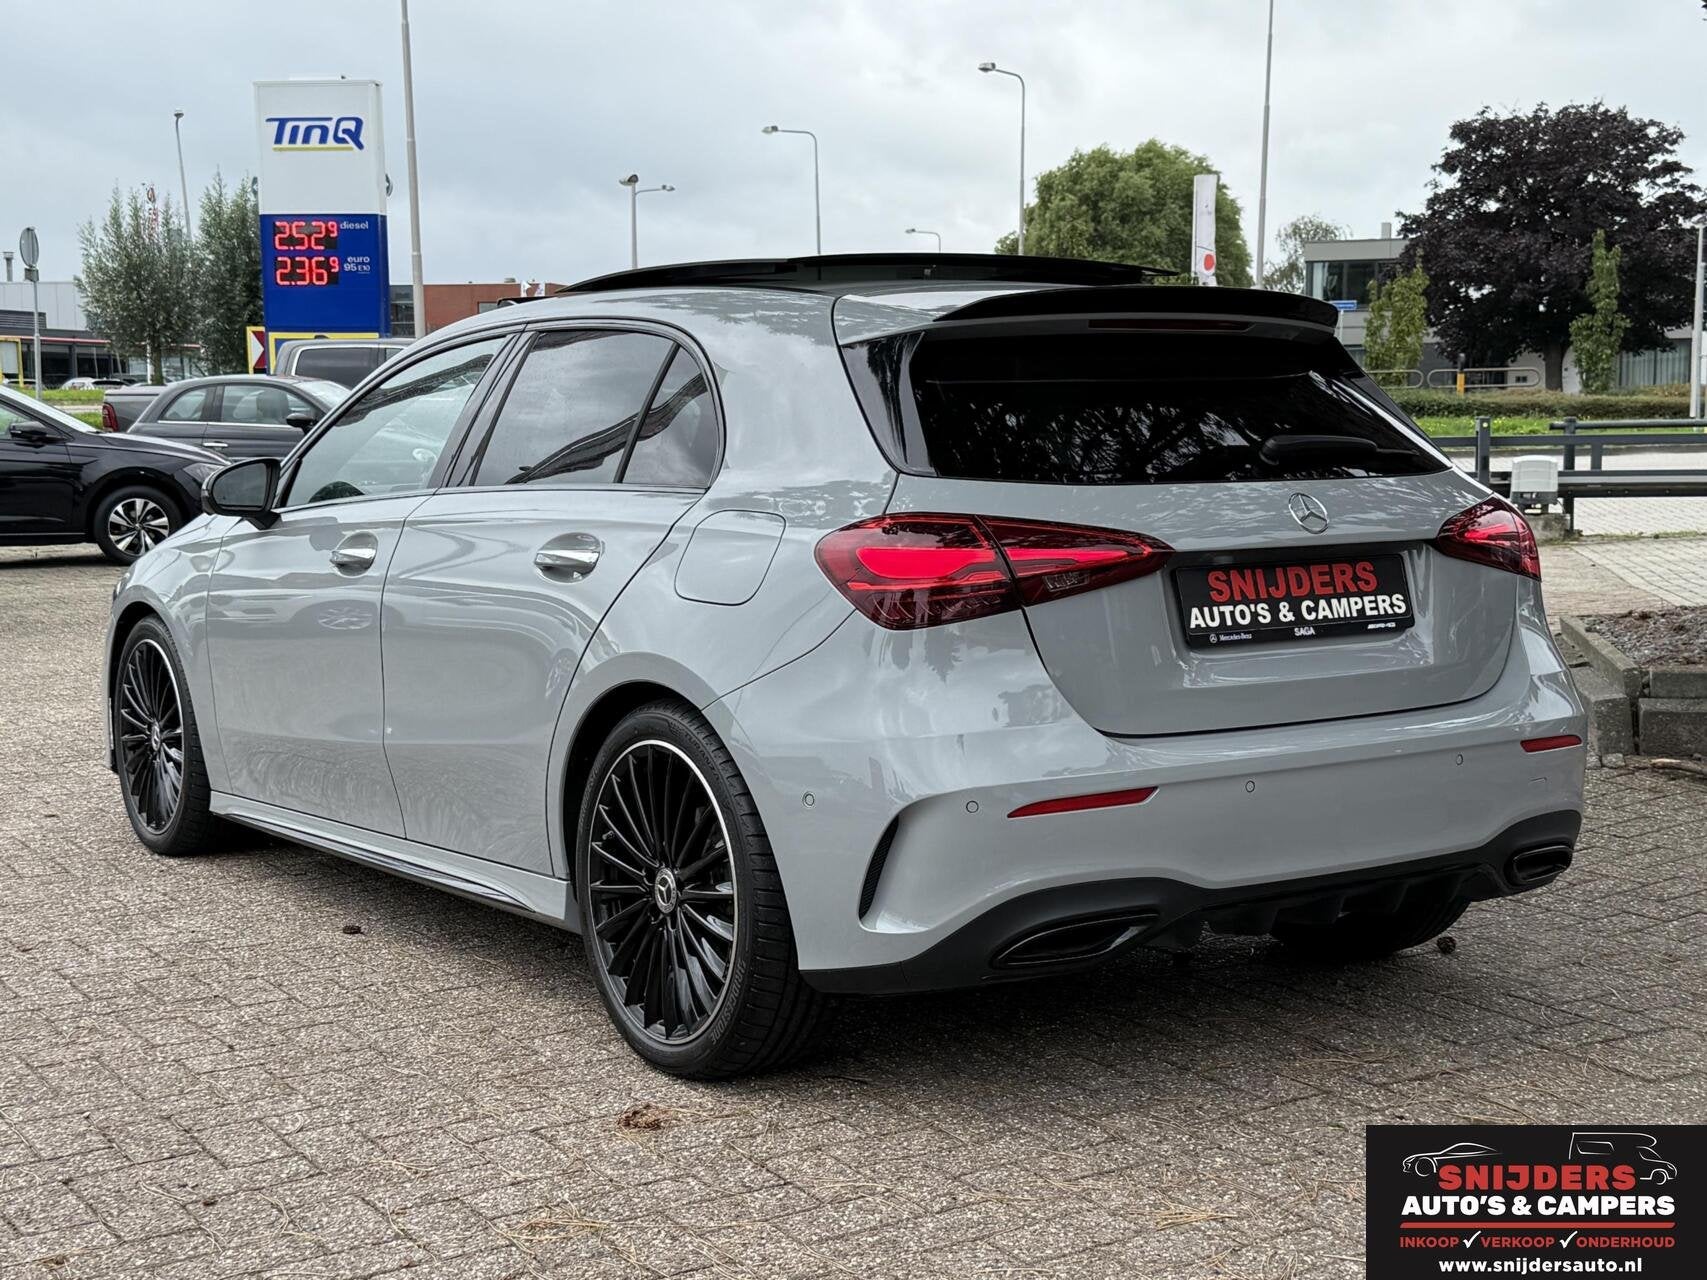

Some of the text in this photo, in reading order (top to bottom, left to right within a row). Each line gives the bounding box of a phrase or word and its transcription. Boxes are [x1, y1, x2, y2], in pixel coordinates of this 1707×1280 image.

[265, 116, 364, 150] TinQ
[340, 221, 369, 230] diesel
[344, 263, 357, 272] 95
[1208, 561, 1378, 603] SNIJDERS
[1189, 593, 1407, 629] AUTO'S & CAMPERS
[1294, 626, 1316, 637] SAGA
